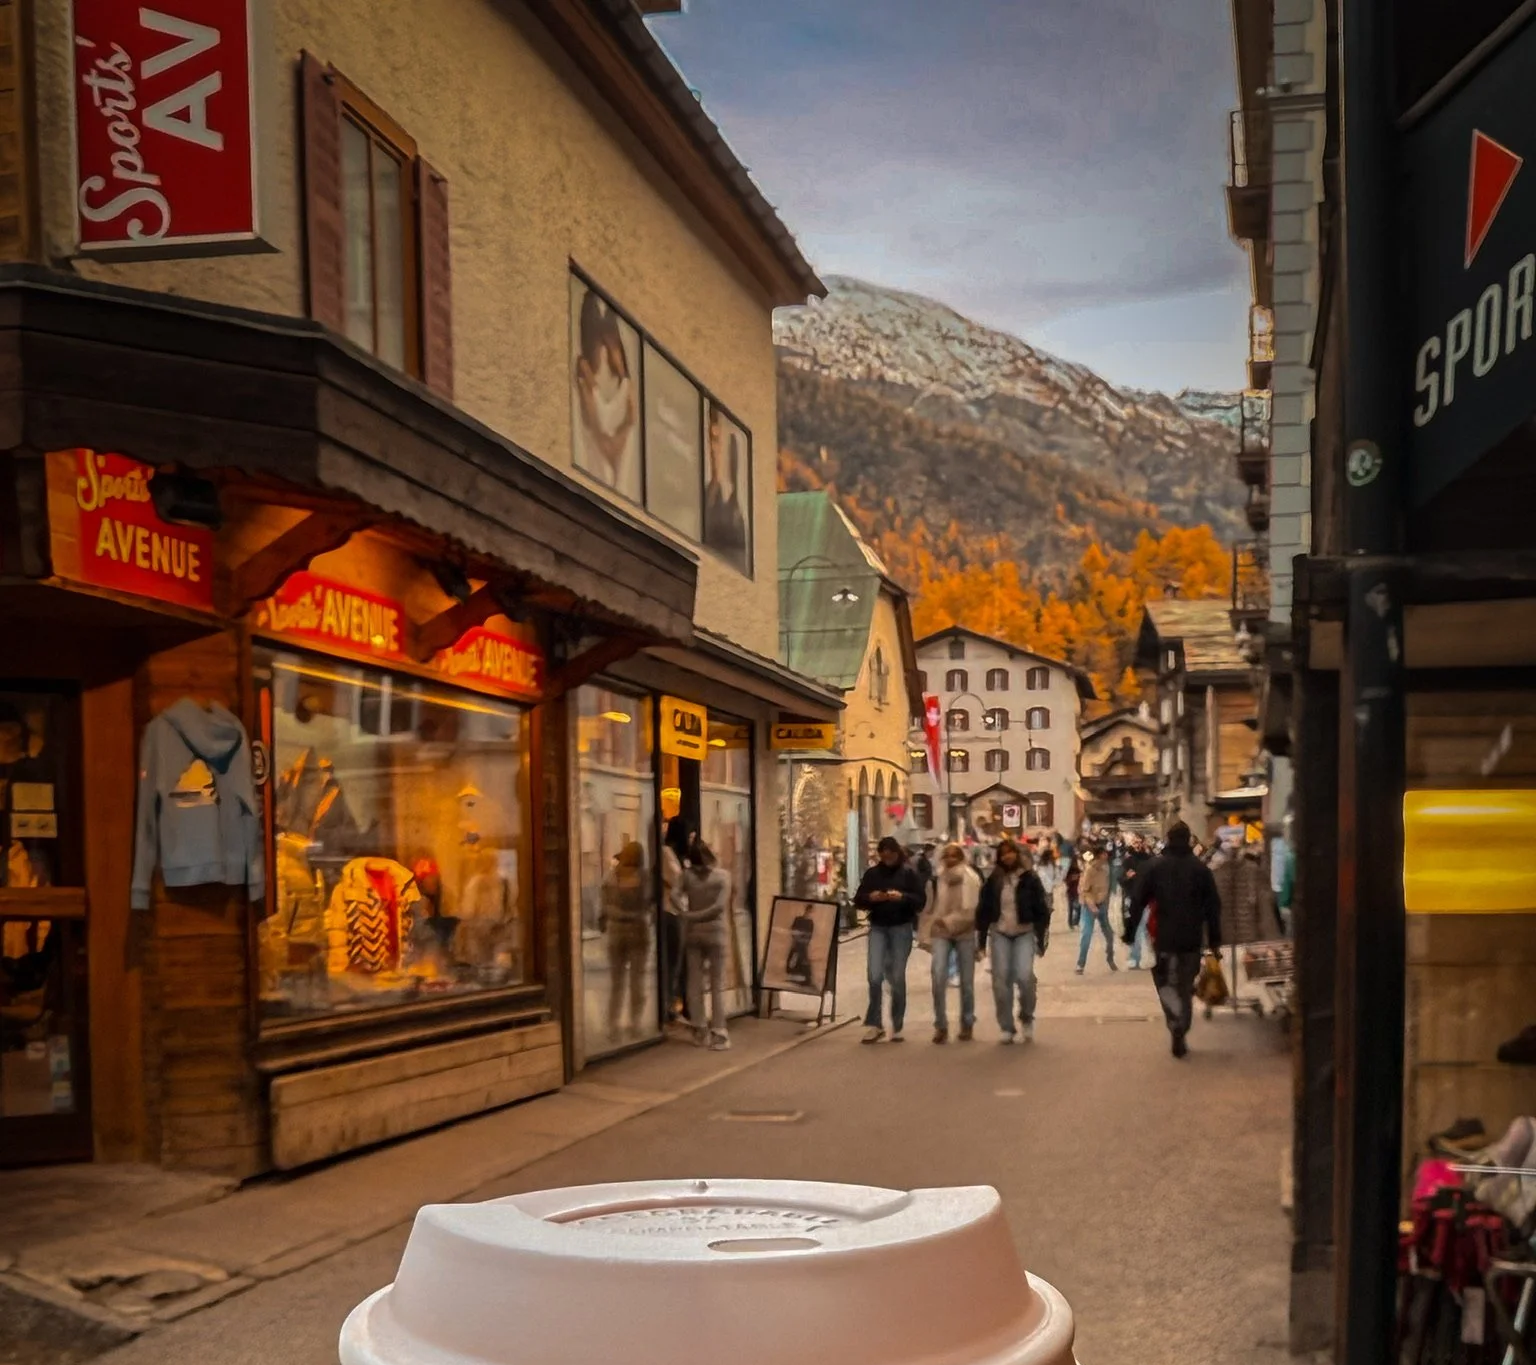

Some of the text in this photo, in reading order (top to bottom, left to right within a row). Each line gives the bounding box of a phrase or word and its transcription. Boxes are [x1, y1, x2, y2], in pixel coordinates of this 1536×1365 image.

[139, 7, 225, 152] AV
[96, 517, 201, 583] AVENUE
[321, 588, 399, 652] AVENUE
